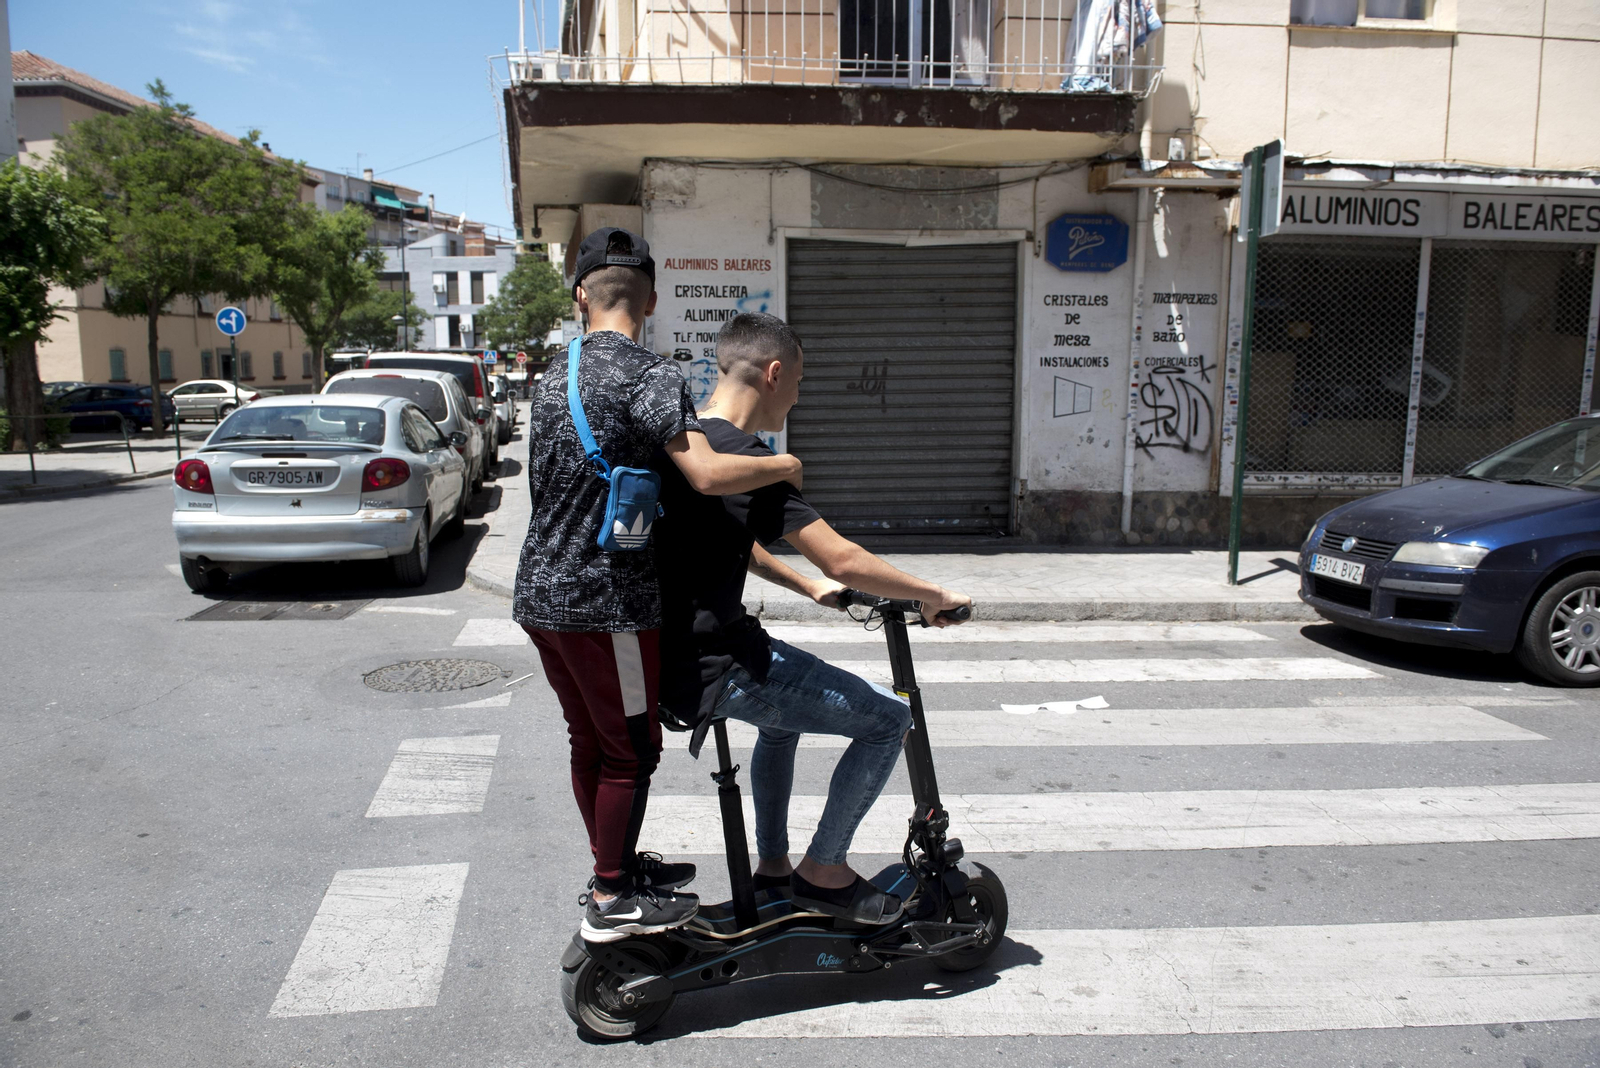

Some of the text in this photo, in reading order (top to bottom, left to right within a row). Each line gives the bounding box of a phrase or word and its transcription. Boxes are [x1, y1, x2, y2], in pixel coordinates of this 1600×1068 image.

[1281, 195, 1600, 233] ALUMINIOS BALEARES
[664, 258, 771, 271] ALUMINIOS BALEARES
[675, 284, 748, 298] CRISTALERIA
[1040, 356, 1109, 368] INSTALACIONES
[1144, 356, 1199, 367] COMERCIALES
[248, 471, 323, 484] GR-7905-AW
[1316, 556, 1360, 582] 5914 BVZ
